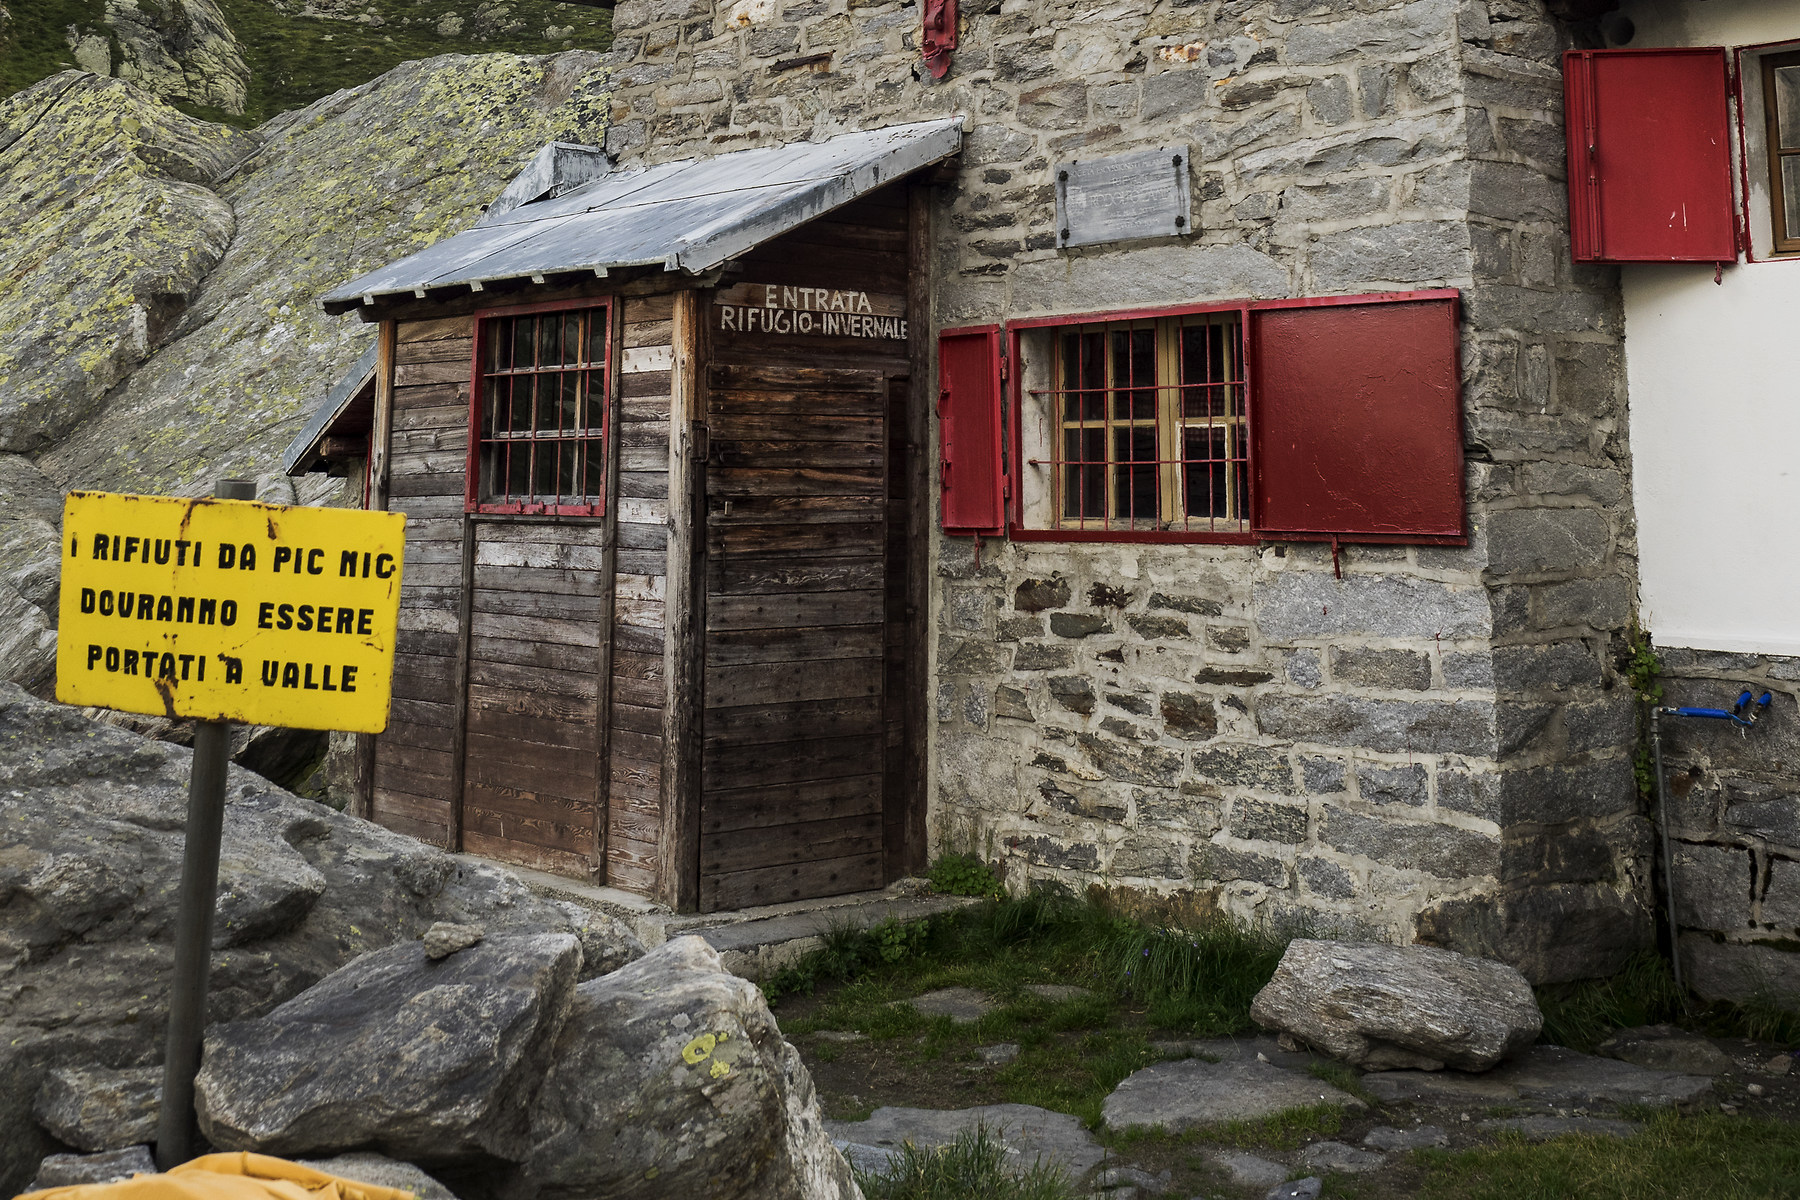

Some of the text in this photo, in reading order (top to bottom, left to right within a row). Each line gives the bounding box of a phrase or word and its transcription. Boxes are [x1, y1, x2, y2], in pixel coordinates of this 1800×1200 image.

[765, 284, 872, 314] ENTRATA
[721, 305, 908, 340] RIFUGIO-INVERNALE
[70, 532, 396, 579] I RIFIUTI DA PIC NIC
[257, 602, 375, 635] ESSERE
[87, 644, 206, 682] PORTATI
[225, 656, 243, 684] A
